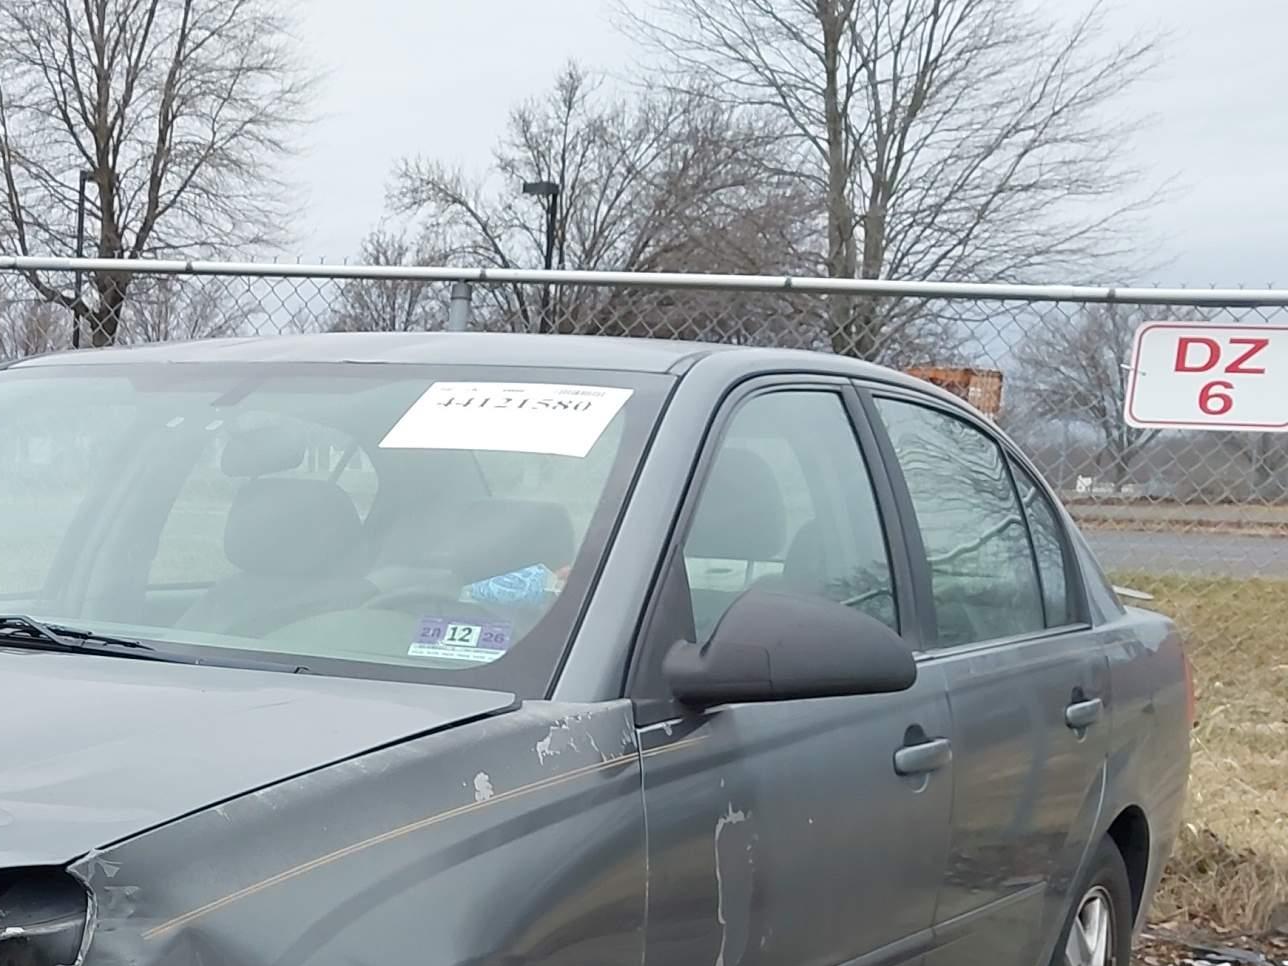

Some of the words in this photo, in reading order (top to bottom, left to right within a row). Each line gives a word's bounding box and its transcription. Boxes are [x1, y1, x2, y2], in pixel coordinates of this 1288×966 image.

[1174, 336, 1269, 374] DZ
[437, 397, 592, 411] 44121580
[1198, 380, 1234, 416] 6
[447, 626, 473, 643] 12
[483, 633, 505, 643] 26
